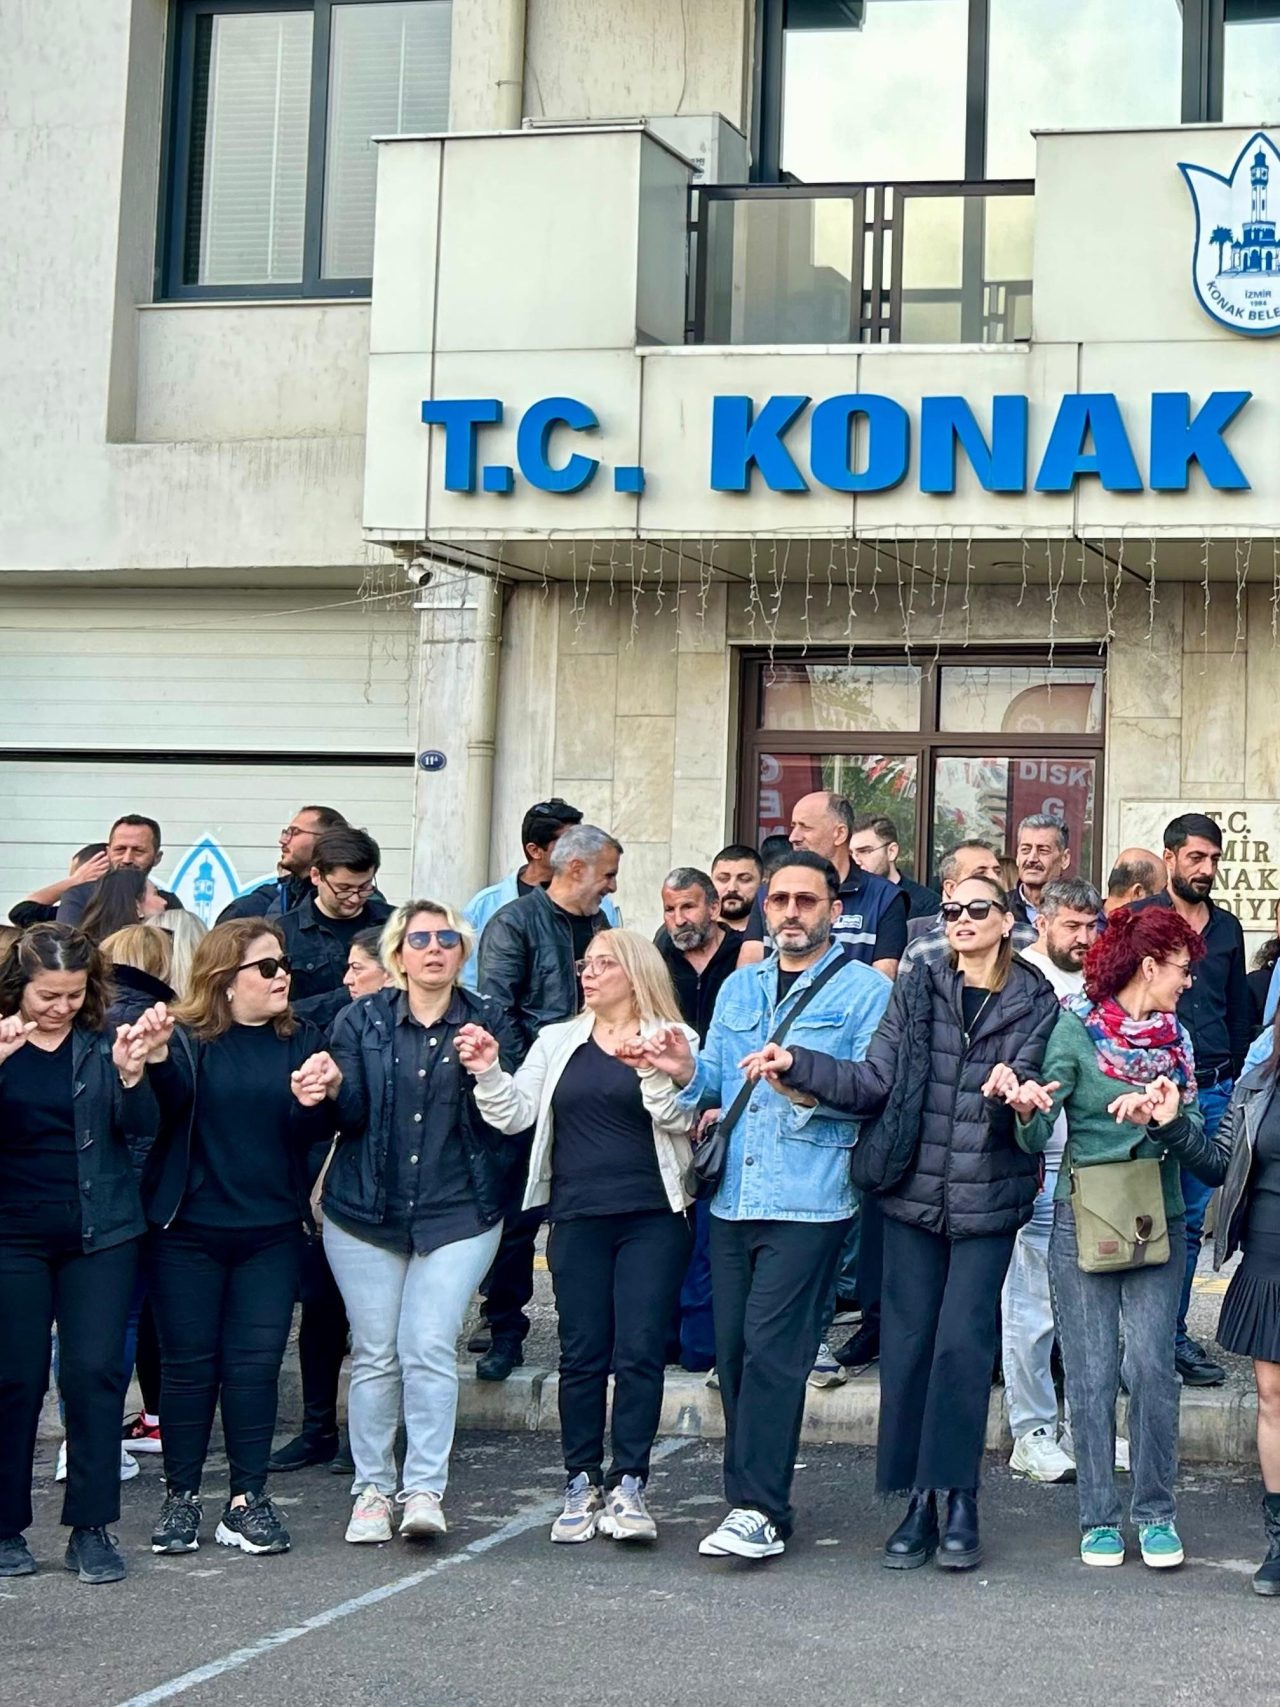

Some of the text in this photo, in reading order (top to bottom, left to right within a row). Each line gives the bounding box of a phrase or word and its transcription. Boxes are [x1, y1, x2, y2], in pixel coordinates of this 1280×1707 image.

[1206, 280, 1245, 319] KONAK
[1244, 288, 1272, 299] İZMİR
[422, 396, 645, 495] T.C.
[709, 391, 1254, 494] KONAK
